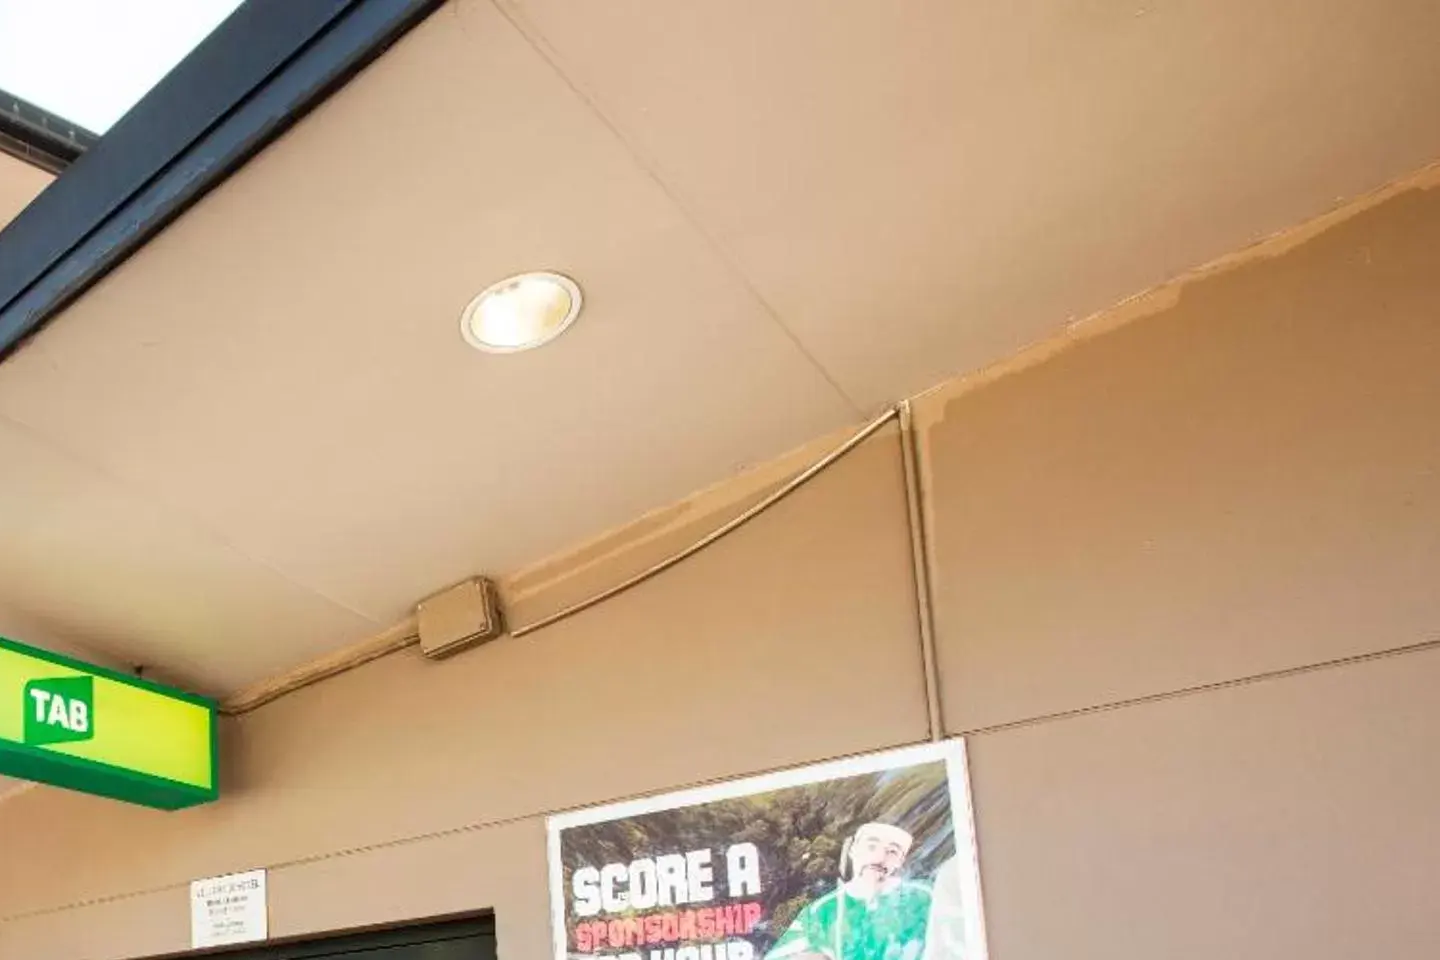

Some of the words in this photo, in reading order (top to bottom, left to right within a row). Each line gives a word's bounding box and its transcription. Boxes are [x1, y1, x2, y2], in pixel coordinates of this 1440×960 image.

[30, 688, 88, 733] TAB
[571, 848, 714, 916] SCORE
[725, 842, 762, 897] A
[574, 901, 762, 952] SPONSORSHIP
